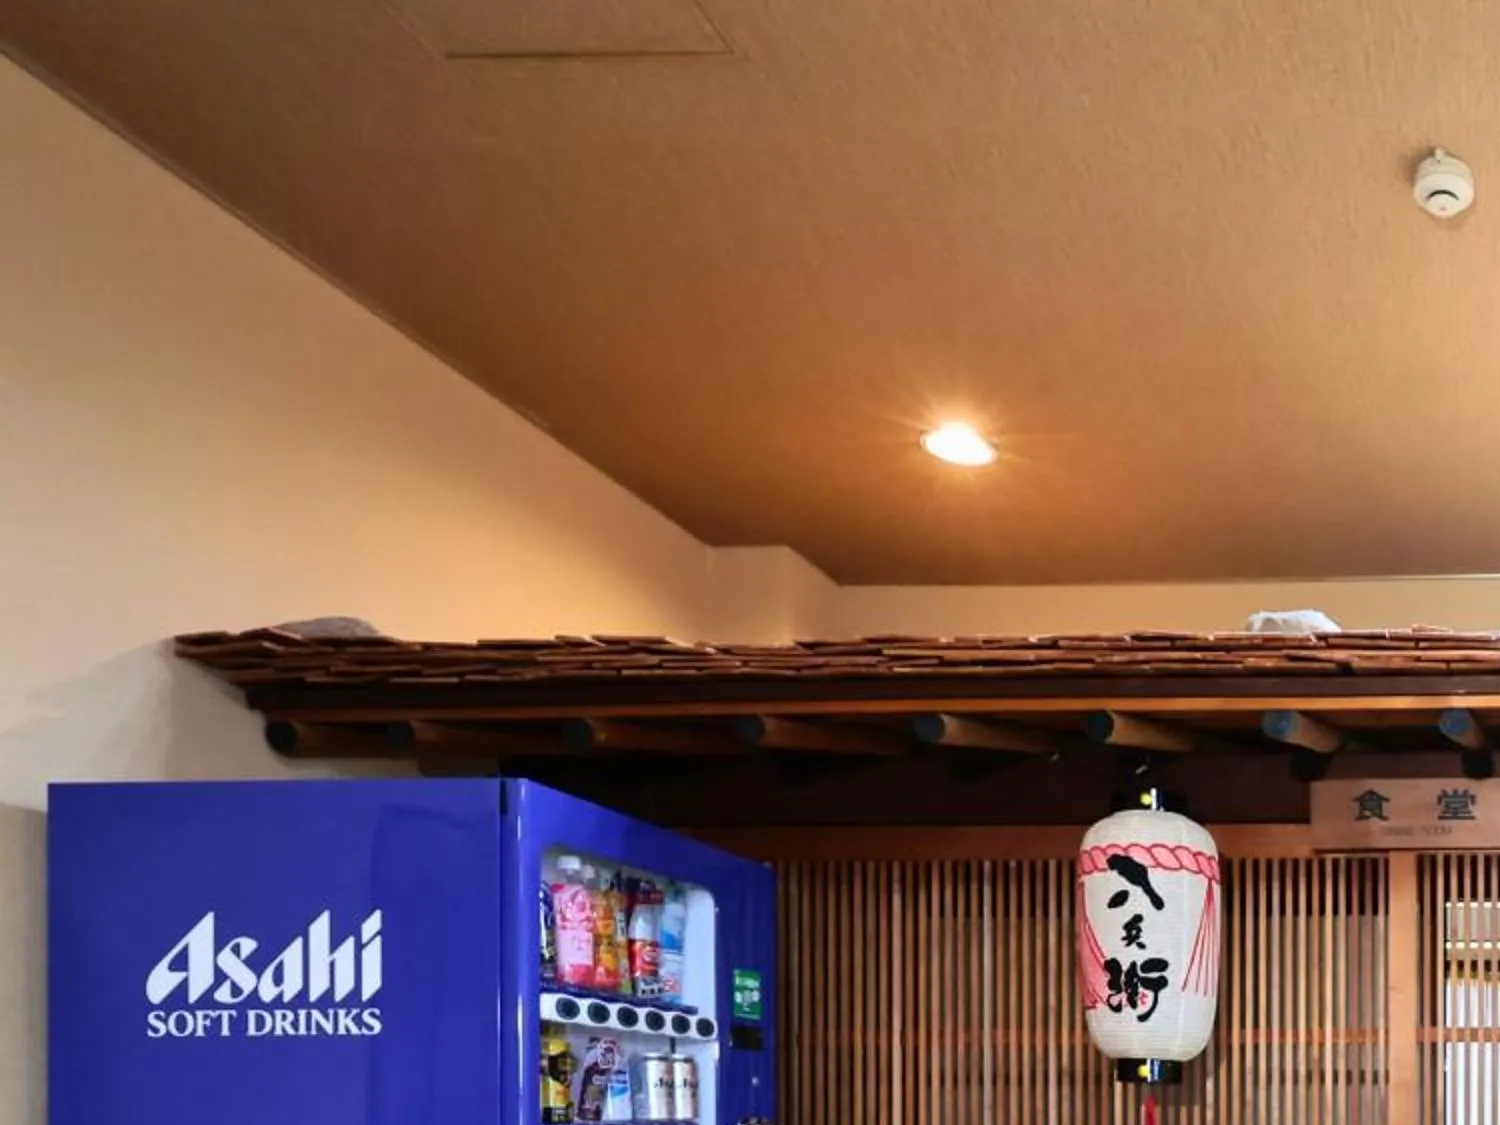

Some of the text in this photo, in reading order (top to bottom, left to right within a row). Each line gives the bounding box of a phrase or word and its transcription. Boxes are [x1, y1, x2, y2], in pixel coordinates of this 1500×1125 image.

[1353, 788, 1477, 822] 食堂
[145, 908, 383, 1006] Asahi
[146, 1007, 383, 1039] SOFT DRINKS
